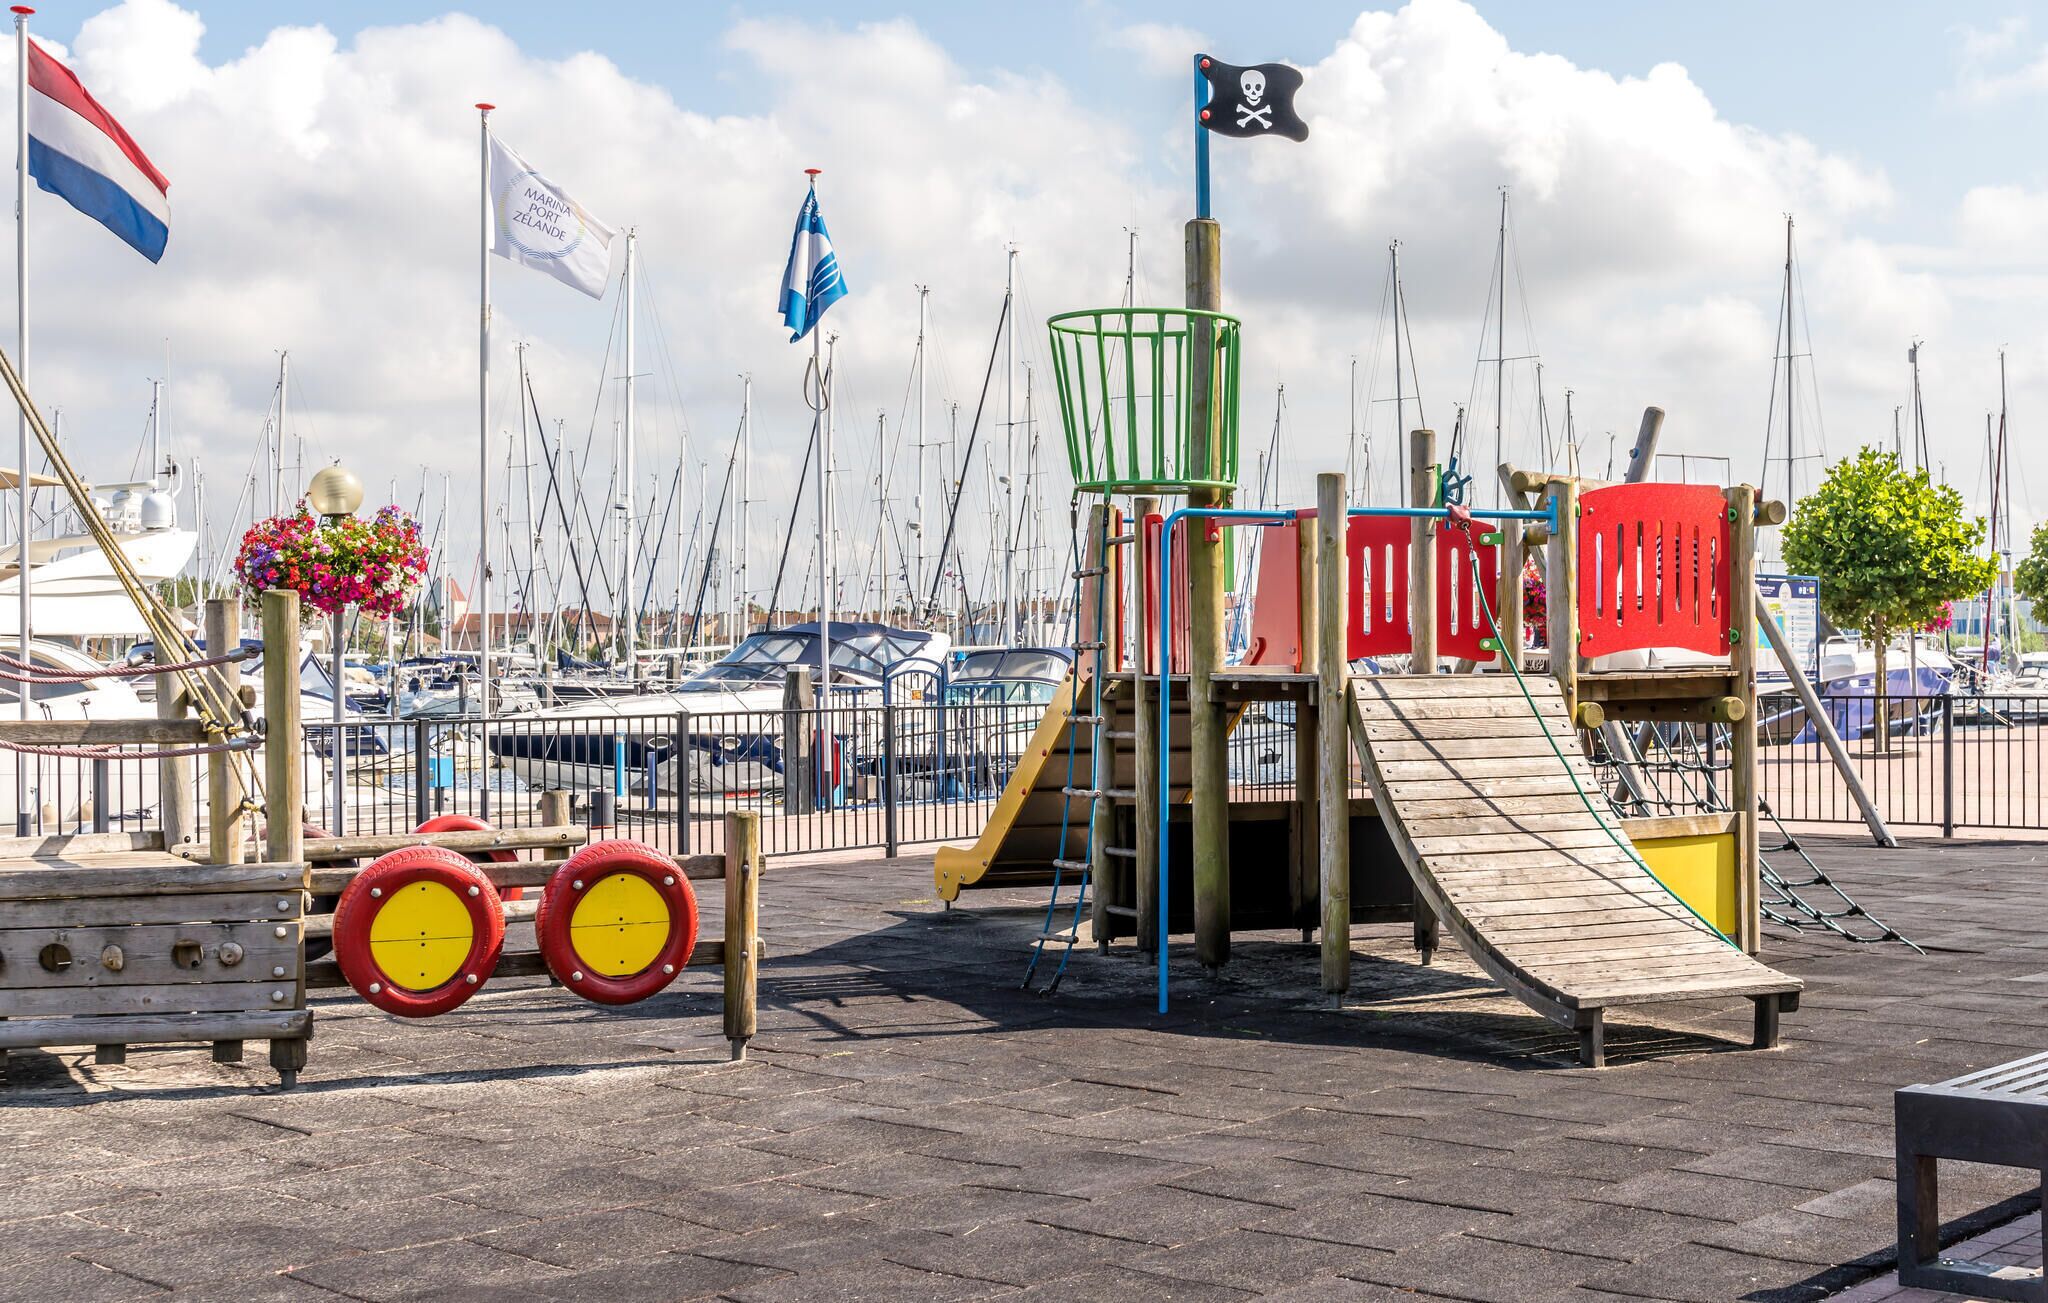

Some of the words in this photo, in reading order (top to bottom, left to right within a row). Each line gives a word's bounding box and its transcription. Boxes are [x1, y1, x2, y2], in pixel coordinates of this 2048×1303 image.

[524, 187, 571, 217] MARINA
[529, 203, 561, 224] PORT
[512, 210, 566, 242] ZÉLANDE
